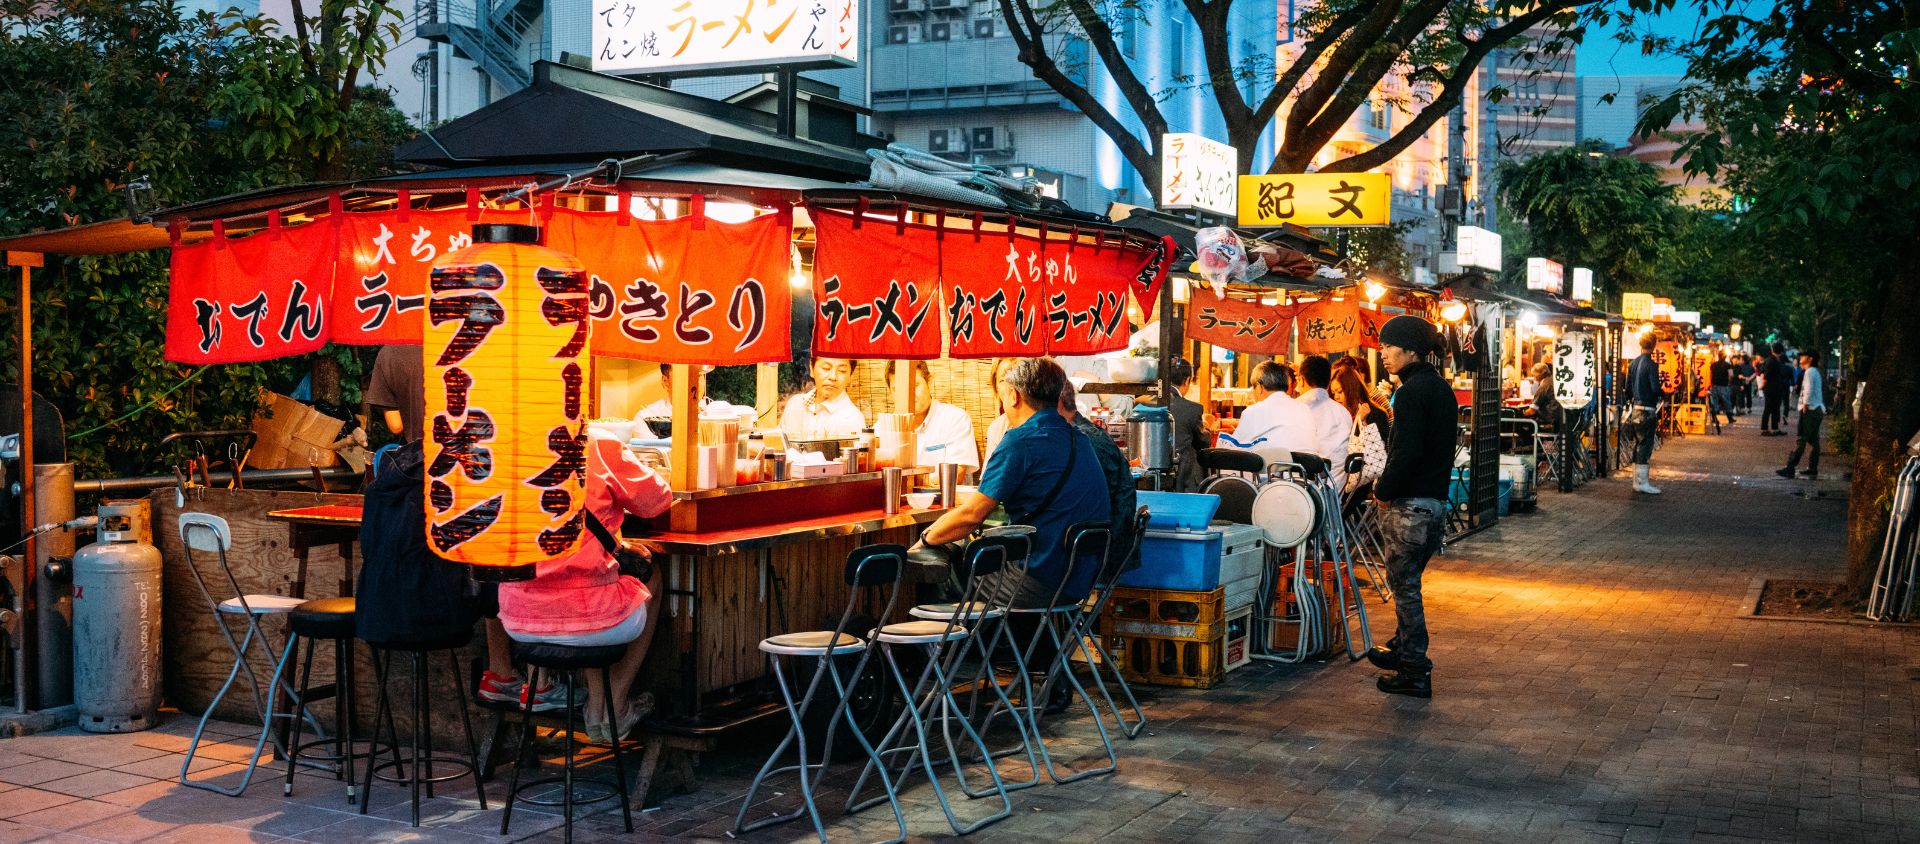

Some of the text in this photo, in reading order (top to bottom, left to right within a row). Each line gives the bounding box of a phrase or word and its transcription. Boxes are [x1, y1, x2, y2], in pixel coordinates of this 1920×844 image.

[666, 0, 799, 58] ラーメン
[1167, 137, 1185, 204] ラーメン
[1257, 180, 1366, 220] 紀文
[193, 279, 324, 354] おでん
[354, 271, 426, 331] ラー
[819, 274, 940, 343] ラーメン
[948, 285, 1036, 346] おでん
[1048, 290, 1127, 342] ラーメン
[1198, 307, 1280, 340] ラーメン
[1305, 314, 1357, 340] 焼ラーメン
[1554, 338, 1575, 397] らーめん
[428, 263, 506, 553] ラーメン
[522, 266, 590, 556] ラーメン
